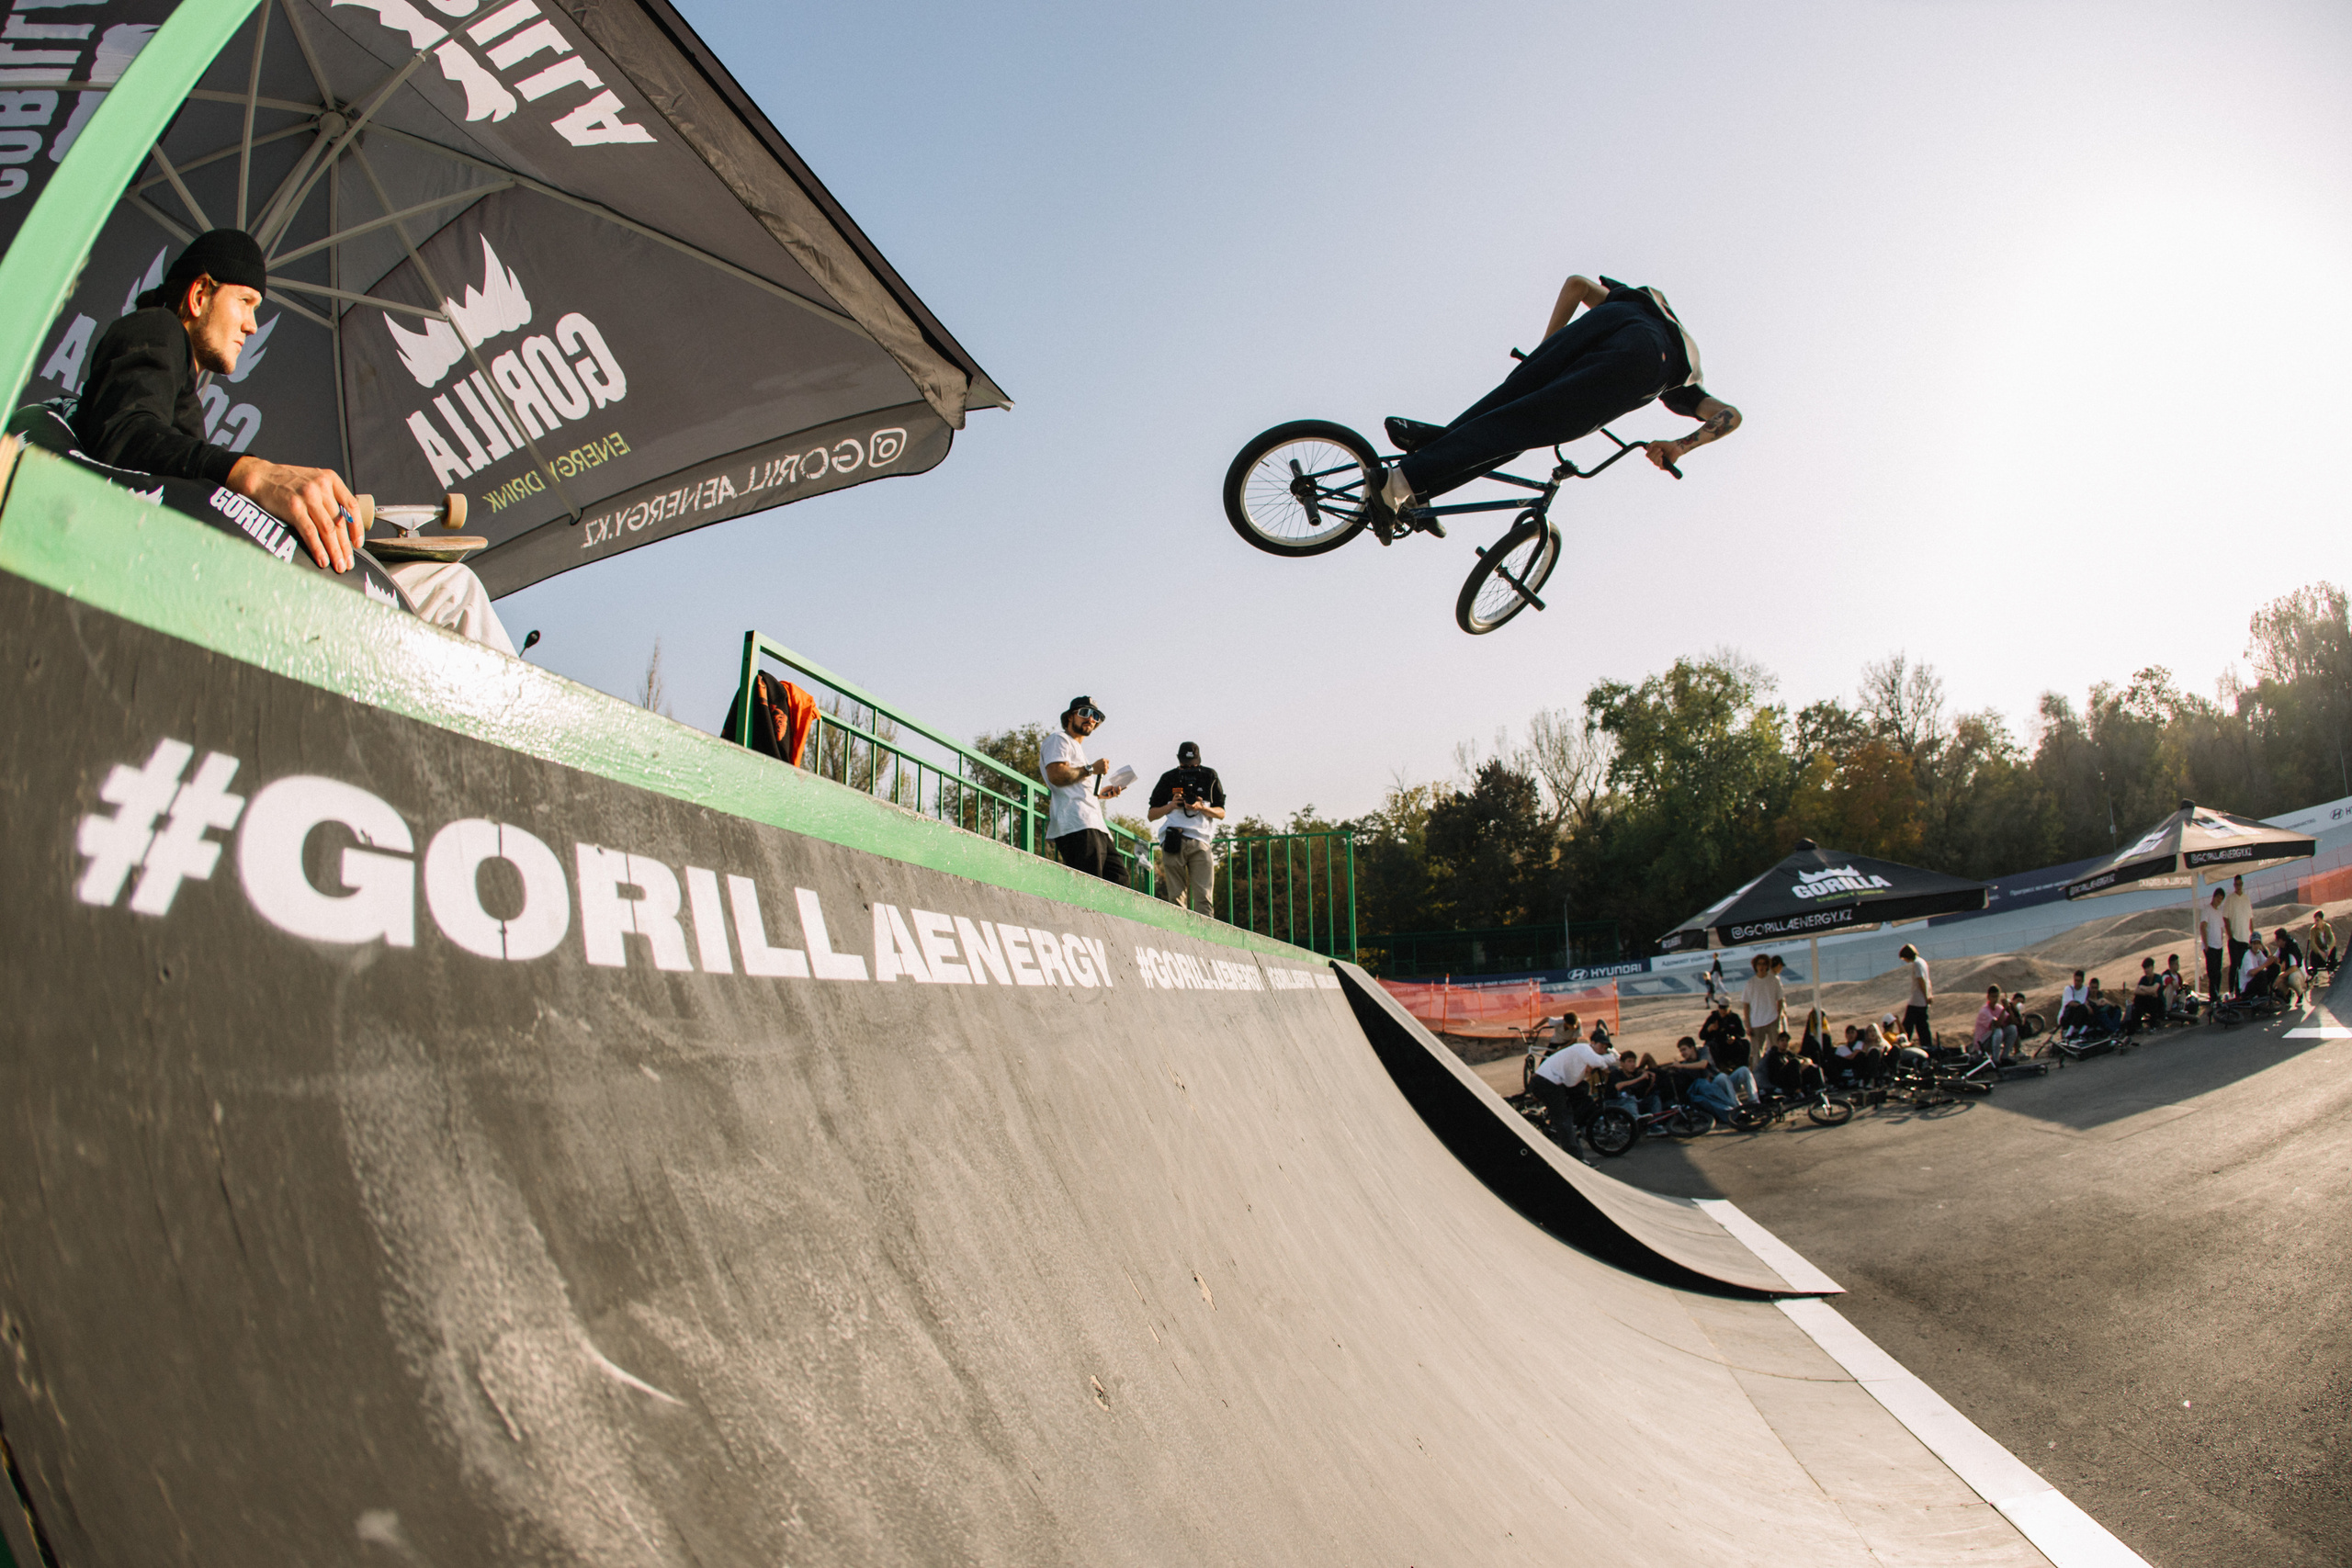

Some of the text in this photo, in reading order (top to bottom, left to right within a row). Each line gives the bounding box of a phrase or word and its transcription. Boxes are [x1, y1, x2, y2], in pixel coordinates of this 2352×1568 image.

[209, 486, 298, 565] GORILLA
[1791, 874, 1894, 899] GORILLA
[1590, 963, 1643, 978] HYUNDAI
